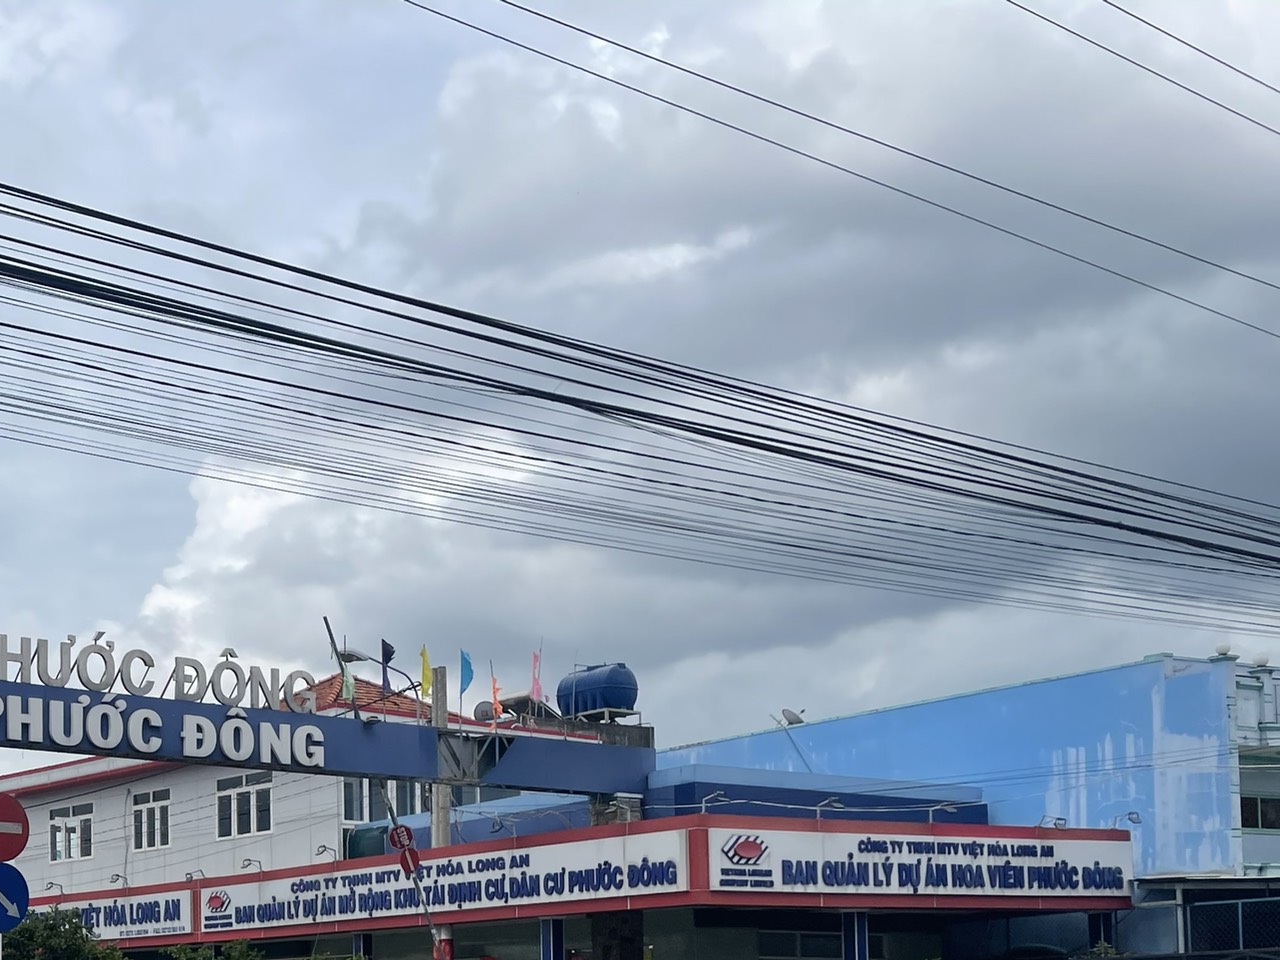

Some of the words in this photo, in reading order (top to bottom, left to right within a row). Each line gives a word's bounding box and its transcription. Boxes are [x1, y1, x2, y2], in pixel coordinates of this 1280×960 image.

[173, 648, 318, 714] ĐÔNG
[180, 708, 325, 768] ĐÔNG
[857, 837, 888, 855] CÔNG
[890, 841, 904, 854] TY
[234, 906, 256, 924] BAN
[256, 896, 286, 921] QUẢN
[286, 895, 301, 920] LÝ
[320, 892, 336, 916] ÁN
[358, 887, 392, 917] RỘNG
[394, 887, 420, 909] KHU
[423, 879, 445, 907] TÁI
[448, 881, 482, 909] ĐỊNH
[509, 871, 540, 898] DÂN
[543, 867, 566, 896] CƯ
[568, 861, 624, 892] PHƯỚC
[627, 857, 677, 888] ĐÔNG
[291, 878, 321, 894] CÔNG
[323, 877, 339, 889] TY
[404, 864, 433, 882] ỆT
[436, 858, 464, 878] HÓA
[467, 856, 506, 874] LONG
[509, 853, 530, 869] AN
[781, 859, 818, 886] BAN
[821, 852, 870, 887] QUẢN
[873, 857, 894, 887] LÝ
[898, 858, 922, 893] DỰ
[924, 857, 948, 888] ÁN
[951, 863, 985, 889] HOA
[987, 860, 1025, 890] VIÊN
[1027, 860, 1080, 890] PHƯỚC
[1081, 861, 1124, 890] ĐÔNG
[104, 899, 127, 927] HÓA
[129, 900, 161, 925] LONG
[164, 899, 181, 922] AN
